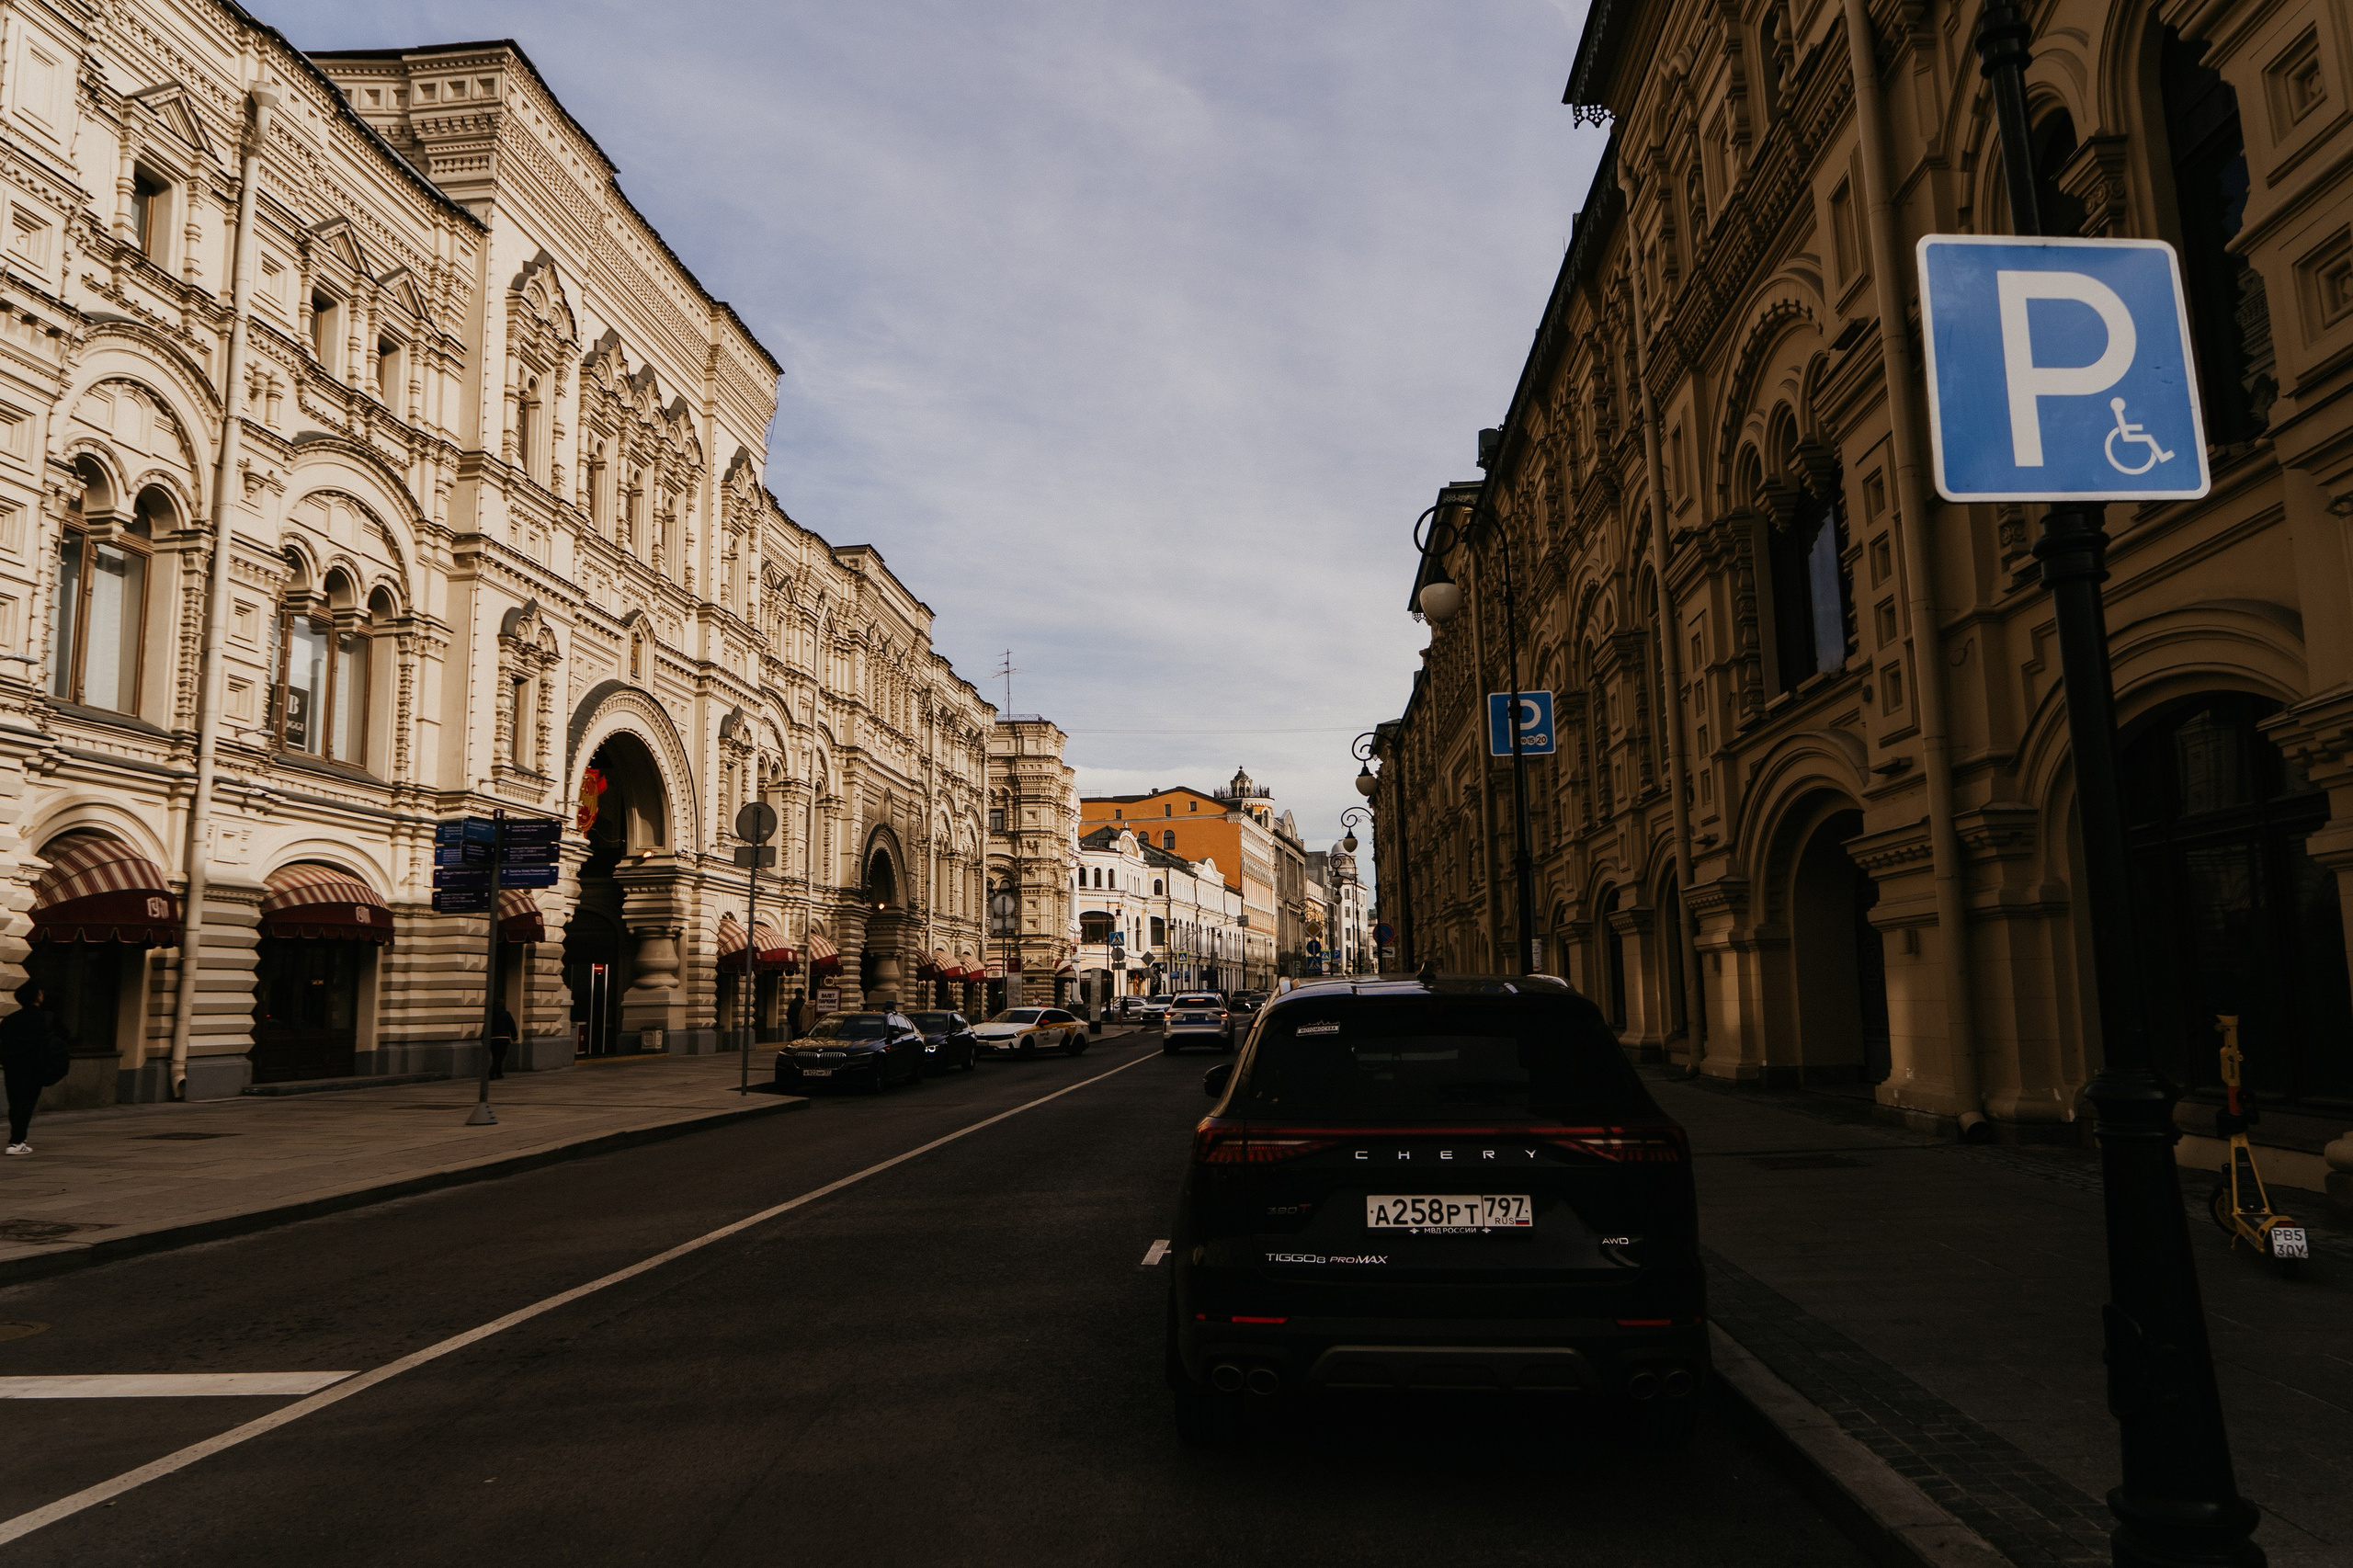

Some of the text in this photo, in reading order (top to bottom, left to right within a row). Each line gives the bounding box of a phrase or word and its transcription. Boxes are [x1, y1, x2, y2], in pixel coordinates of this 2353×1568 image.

[1996, 270, 2137, 467] P
[1507, 699, 1541, 748] P
[1354, 1149, 1537, 1160] CHERY
[1375, 1198, 1525, 1225] А258РТ 797
